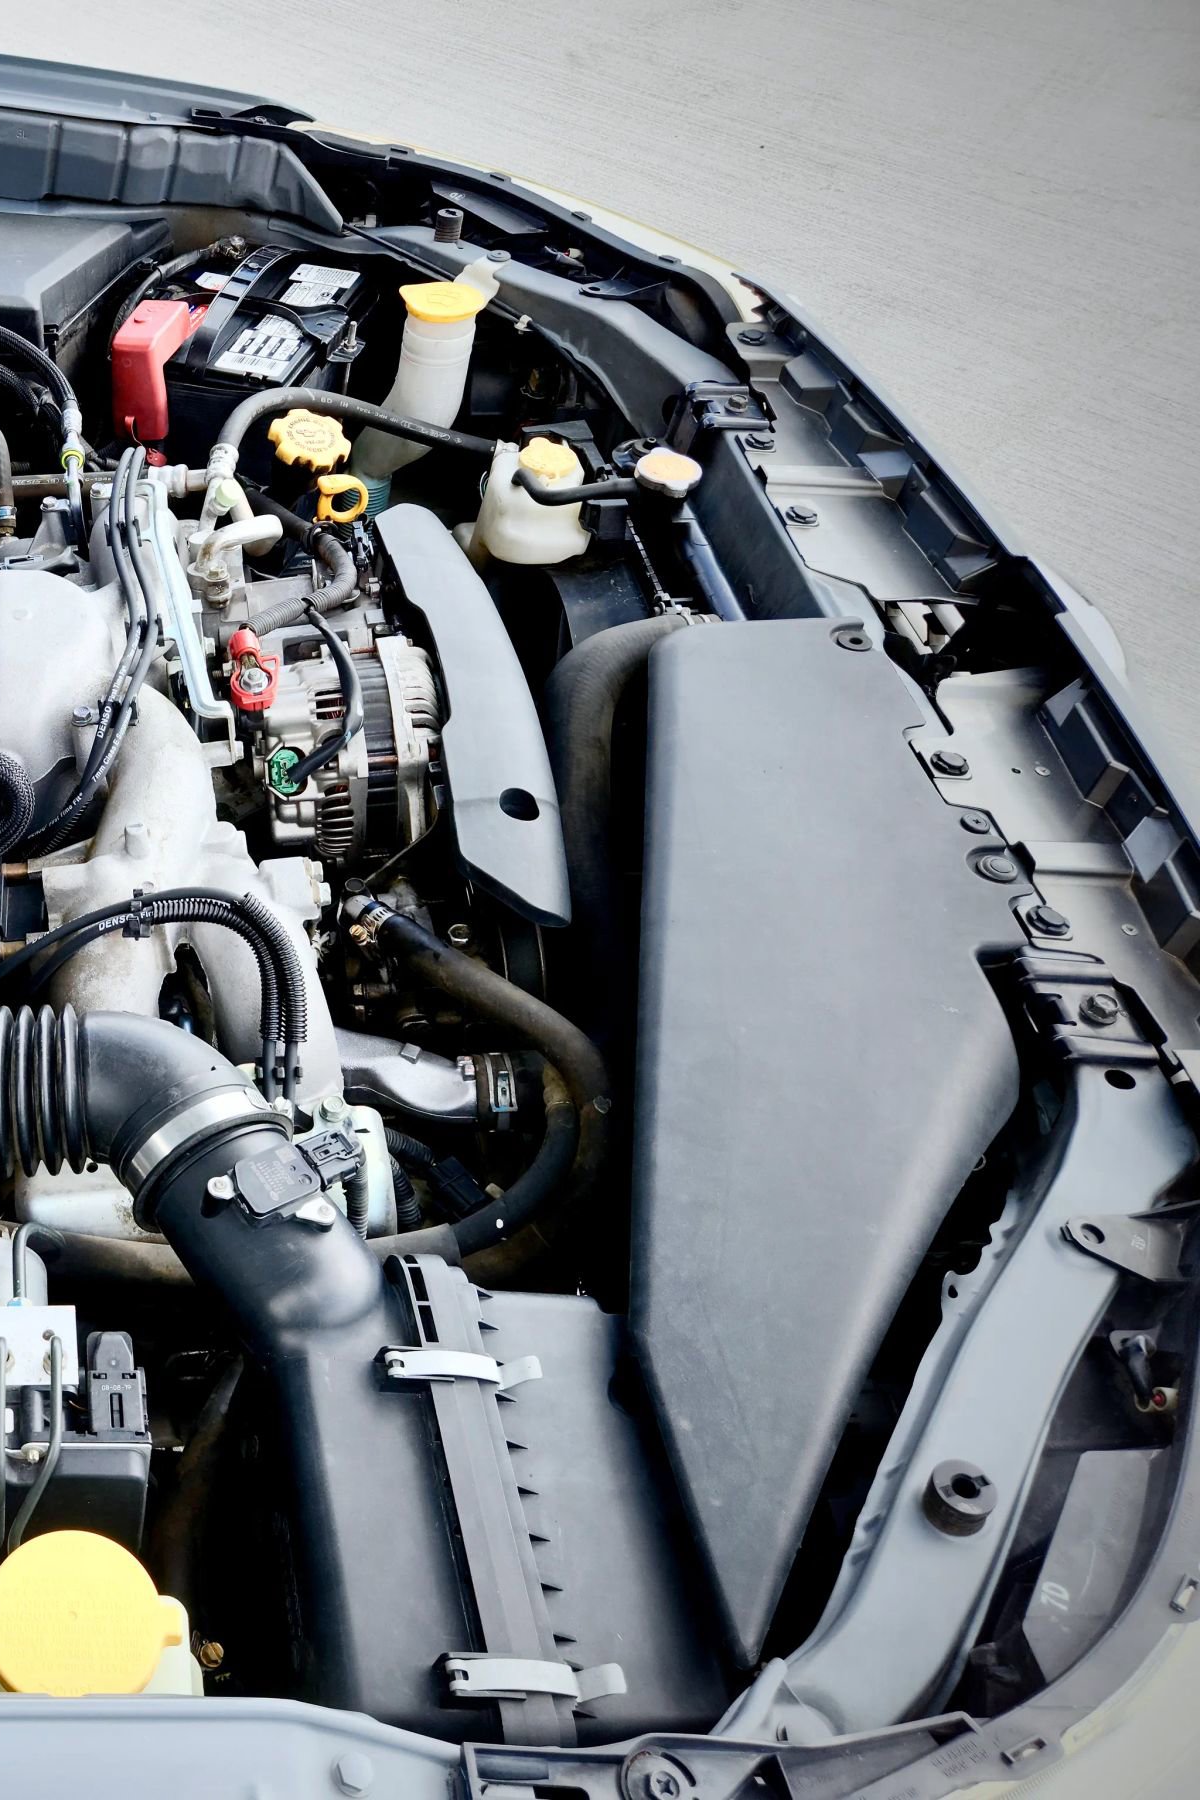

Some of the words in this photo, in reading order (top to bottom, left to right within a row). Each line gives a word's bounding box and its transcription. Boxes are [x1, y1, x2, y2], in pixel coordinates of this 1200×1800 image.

[97, 705, 112, 739] DENSO
[91, 765, 107, 783] 7mm
[102, 745, 118, 765] Class
[112, 738, 121, 746] E
